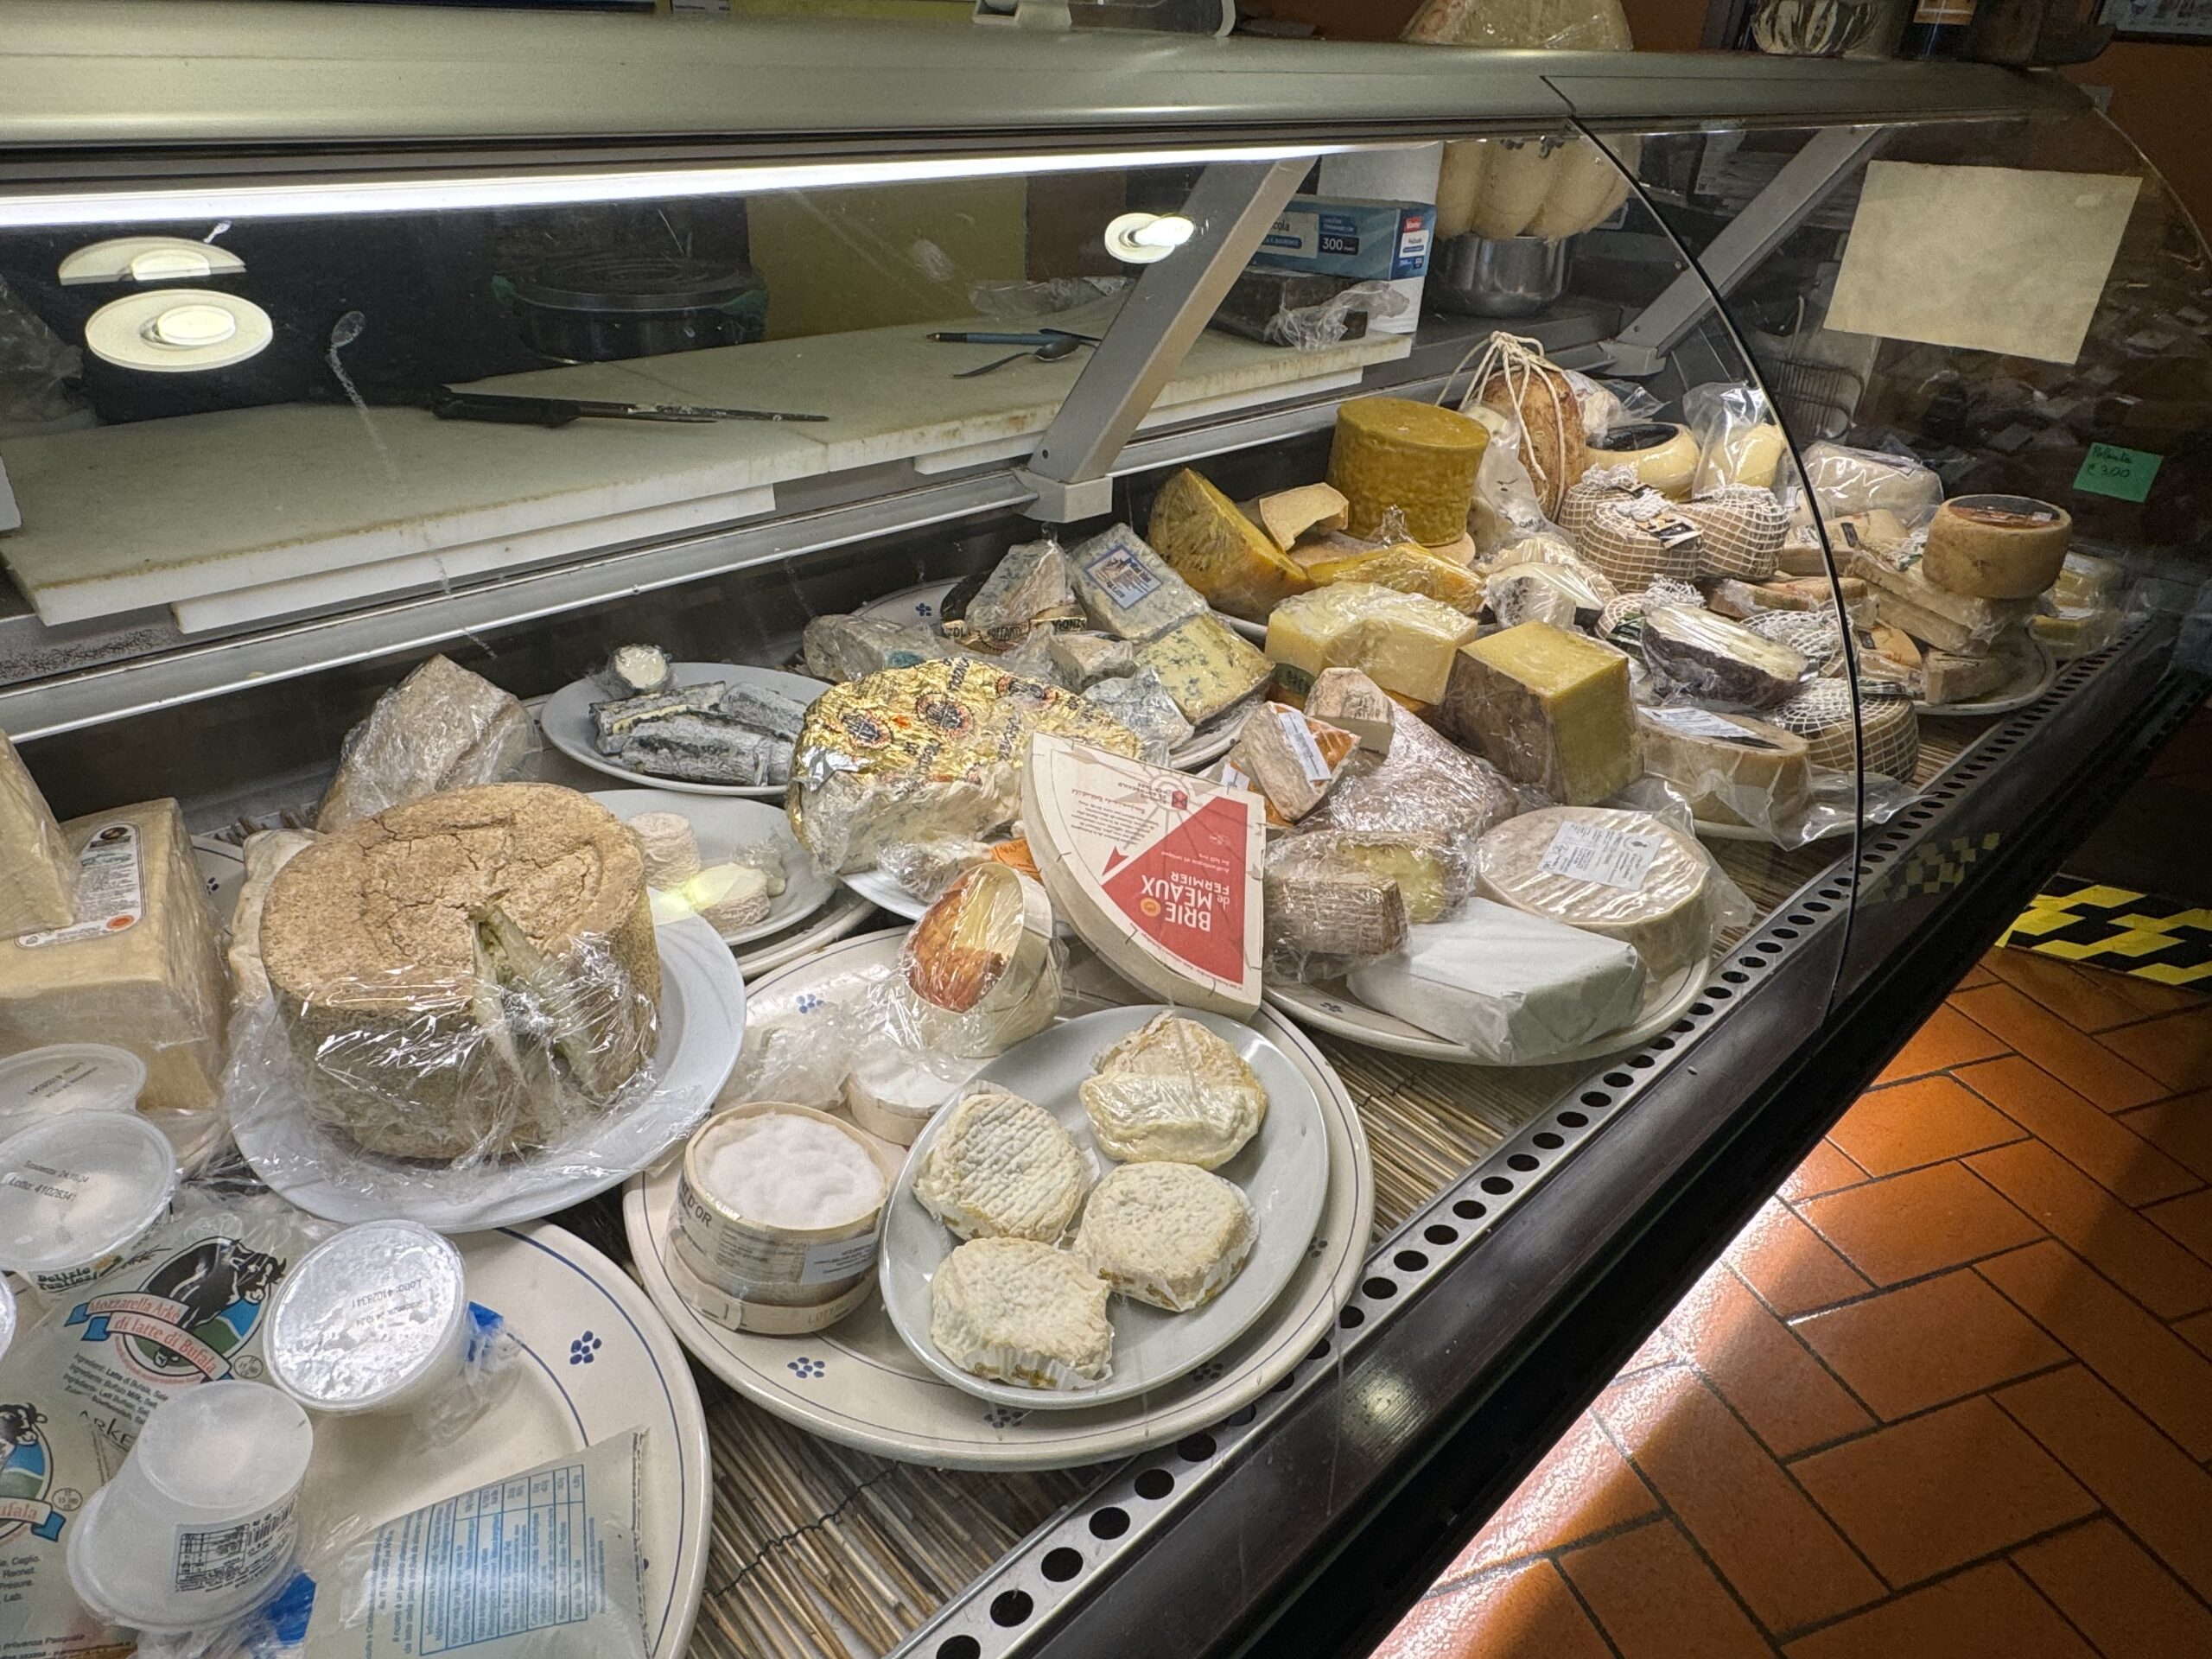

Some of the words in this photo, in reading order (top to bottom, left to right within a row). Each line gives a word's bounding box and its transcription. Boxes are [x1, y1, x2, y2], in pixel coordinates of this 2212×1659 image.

[1322, 237, 1343, 251] 300
[1141, 874, 1211, 909] MEAUX
[1171, 871, 1230, 895] FERMIER
[1217, 894, 1230, 910] de
[1165, 901, 1211, 932] BRIE
[687, 1194, 713, 1228] D'OR
[87, 1297, 152, 1312] Mozzarella
[352, 1288, 394, 1308] 41028341
[114, 1316, 125, 1330] di
[132, 1318, 162, 1339] latte
[163, 1332, 180, 1345] di
[180, 1336, 217, 1374] Bufala
